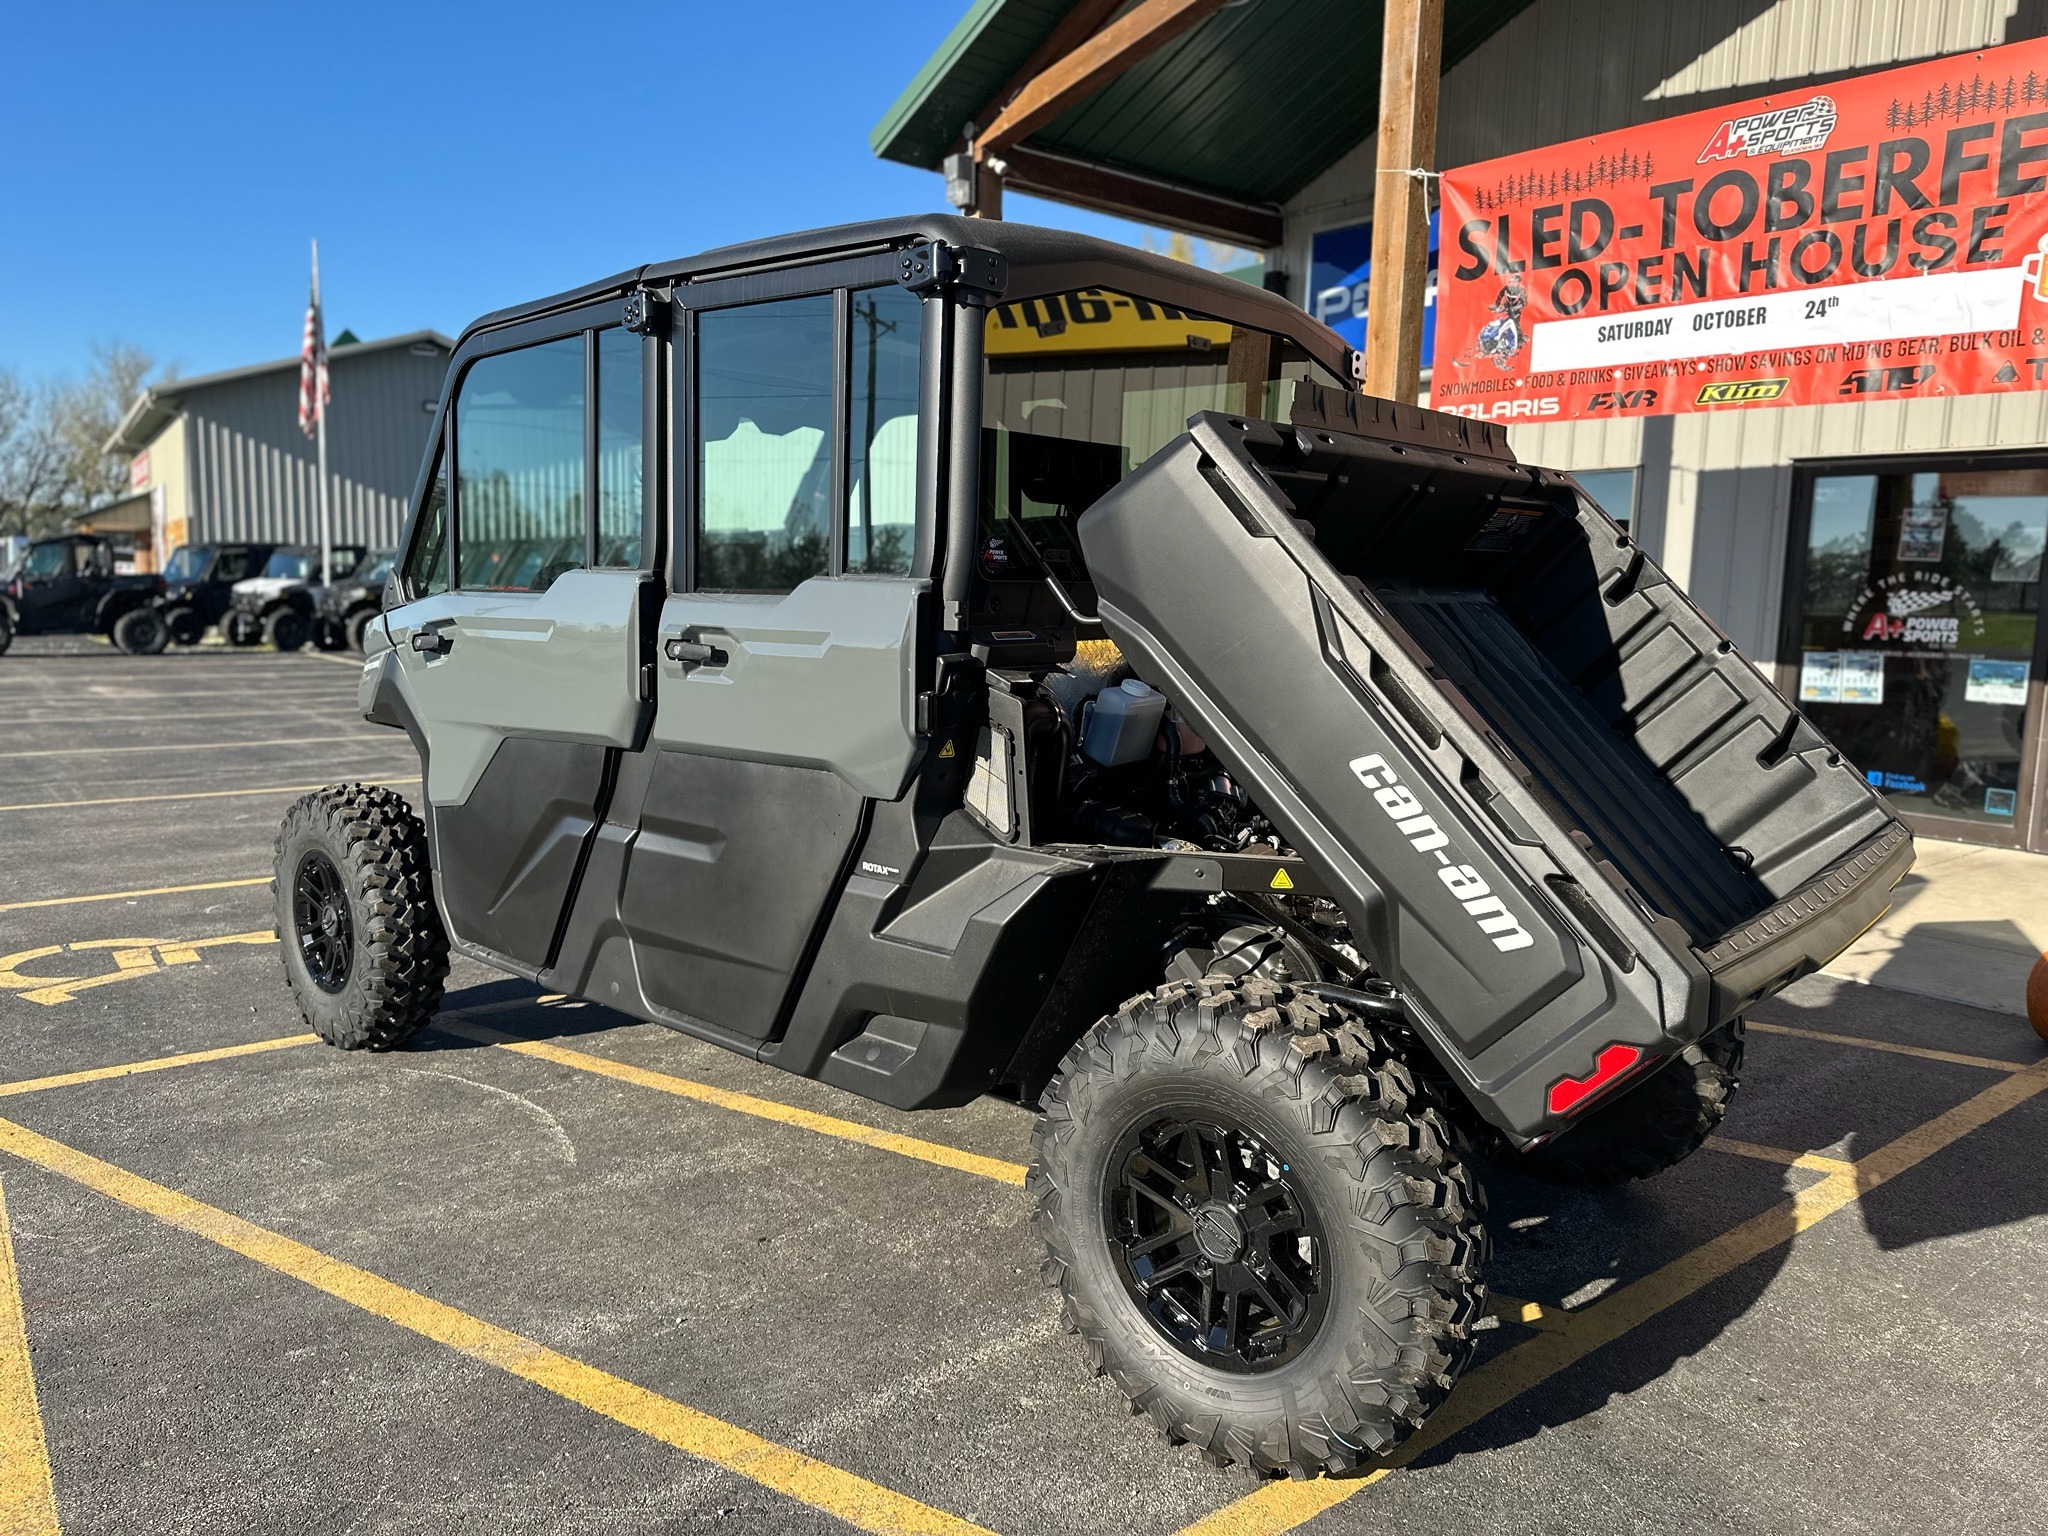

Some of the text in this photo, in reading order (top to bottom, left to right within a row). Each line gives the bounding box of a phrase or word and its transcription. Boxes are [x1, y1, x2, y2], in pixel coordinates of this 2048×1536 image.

[1733, 102, 1819, 135] POWER
[1746, 116, 1835, 147] SPORTS
[1757, 133, 1827, 154] EQUIPMENT
[1550, 203, 2010, 316] OPEN HOUSE
[1597, 295, 1839, 343] SATURDAY OCTOBER 24th
[1439, 327, 2046, 398] SNOWMOBILES FOOD & DRINKS GIVEAWAYS SHOW SAVINGS ON RIDING GEAR, BULK OIL &
[1586, 389, 1659, 412] FXR
[1841, 569, 1985, 636] WHERE THE RIDE STARTS
[1862, 612, 1960, 641] A+ POWER
[1902, 630, 1960, 643] SPORTS
[862, 861, 889, 876] ROTAX
[1348, 753, 1535, 953] can-am
